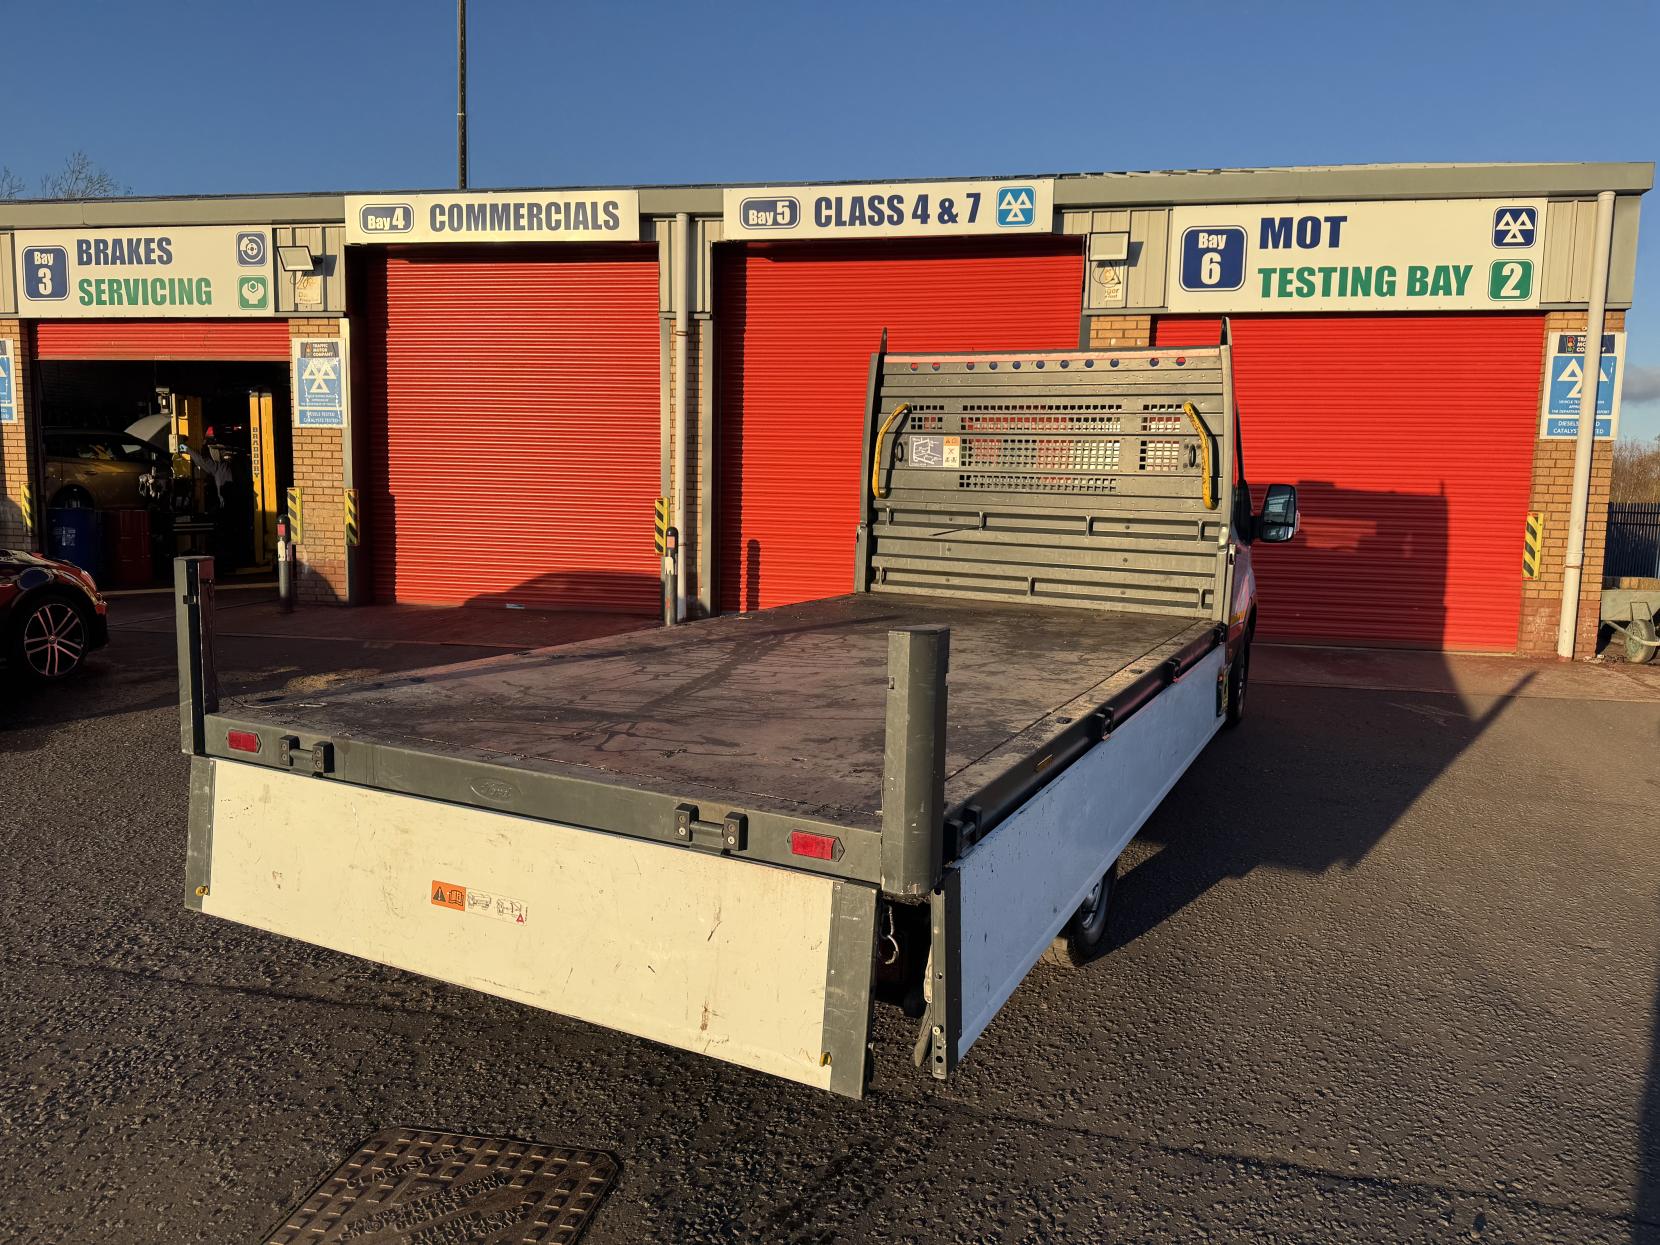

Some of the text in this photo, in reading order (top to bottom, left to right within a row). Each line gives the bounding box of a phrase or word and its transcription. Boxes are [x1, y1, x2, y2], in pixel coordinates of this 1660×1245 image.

[367, 207, 405, 231] Bay 4
[429, 200, 620, 232] COMMERCIALS
[748, 201, 791, 226] Bay 5
[814, 192, 982, 228] CLASS 4 & 7
[1197, 232, 1227, 250] Bay
[1259, 215, 1348, 250] MOT
[33, 251, 54, 266] Bay
[76, 236, 173, 267] BRAKES
[37, 268, 53, 296] 3
[1200, 251, 1221, 286] 6
[1257, 264, 1474, 298] TESTING BAY
[1501, 263, 1522, 297] 2
[78, 277, 213, 307] SERVICING
[252, 427, 260, 478] BRADBURY
[346, 1147, 460, 1189] CLARKSTEEL
